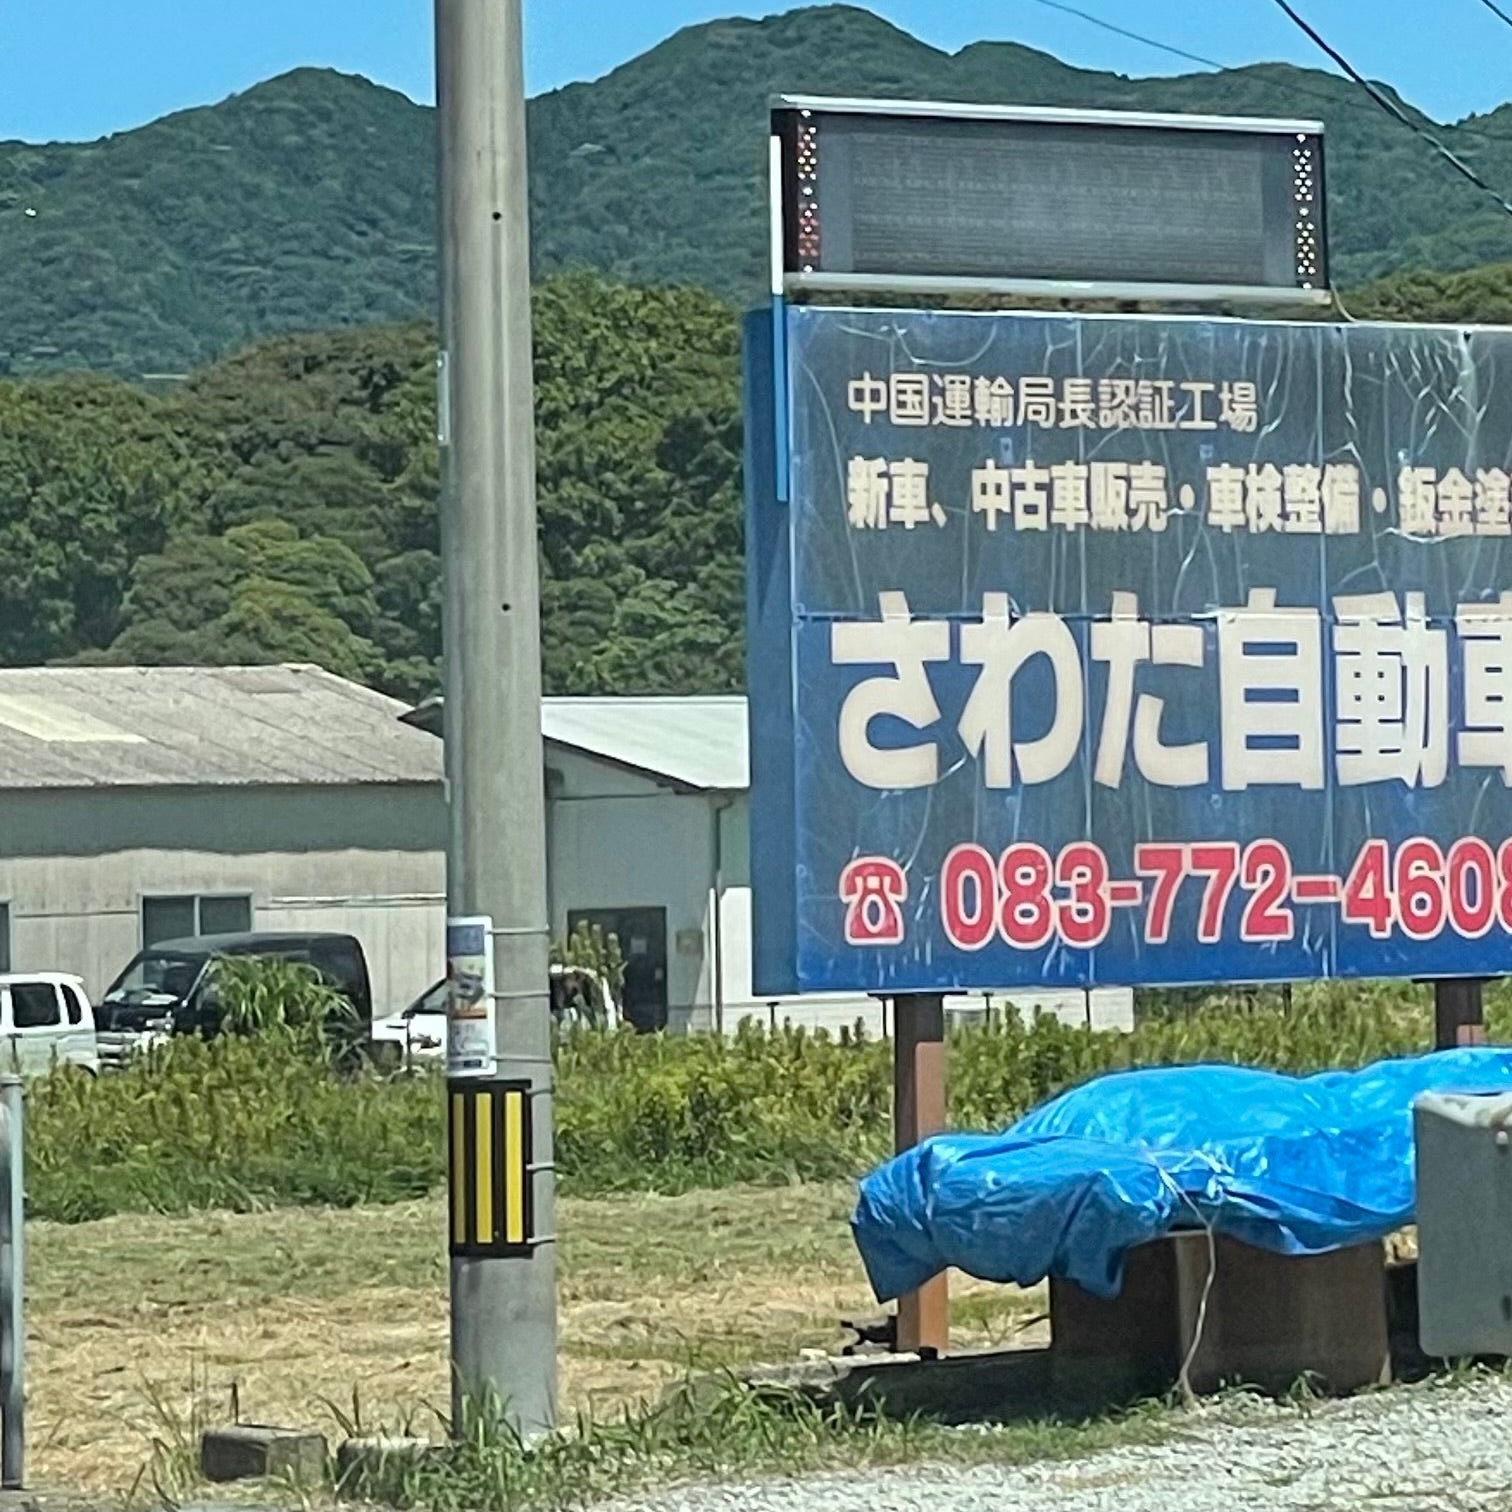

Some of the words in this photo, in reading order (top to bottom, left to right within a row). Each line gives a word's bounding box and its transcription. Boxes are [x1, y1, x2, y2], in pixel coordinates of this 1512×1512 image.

[847, 372, 1258, 433] 中国運輸局長認証工場
